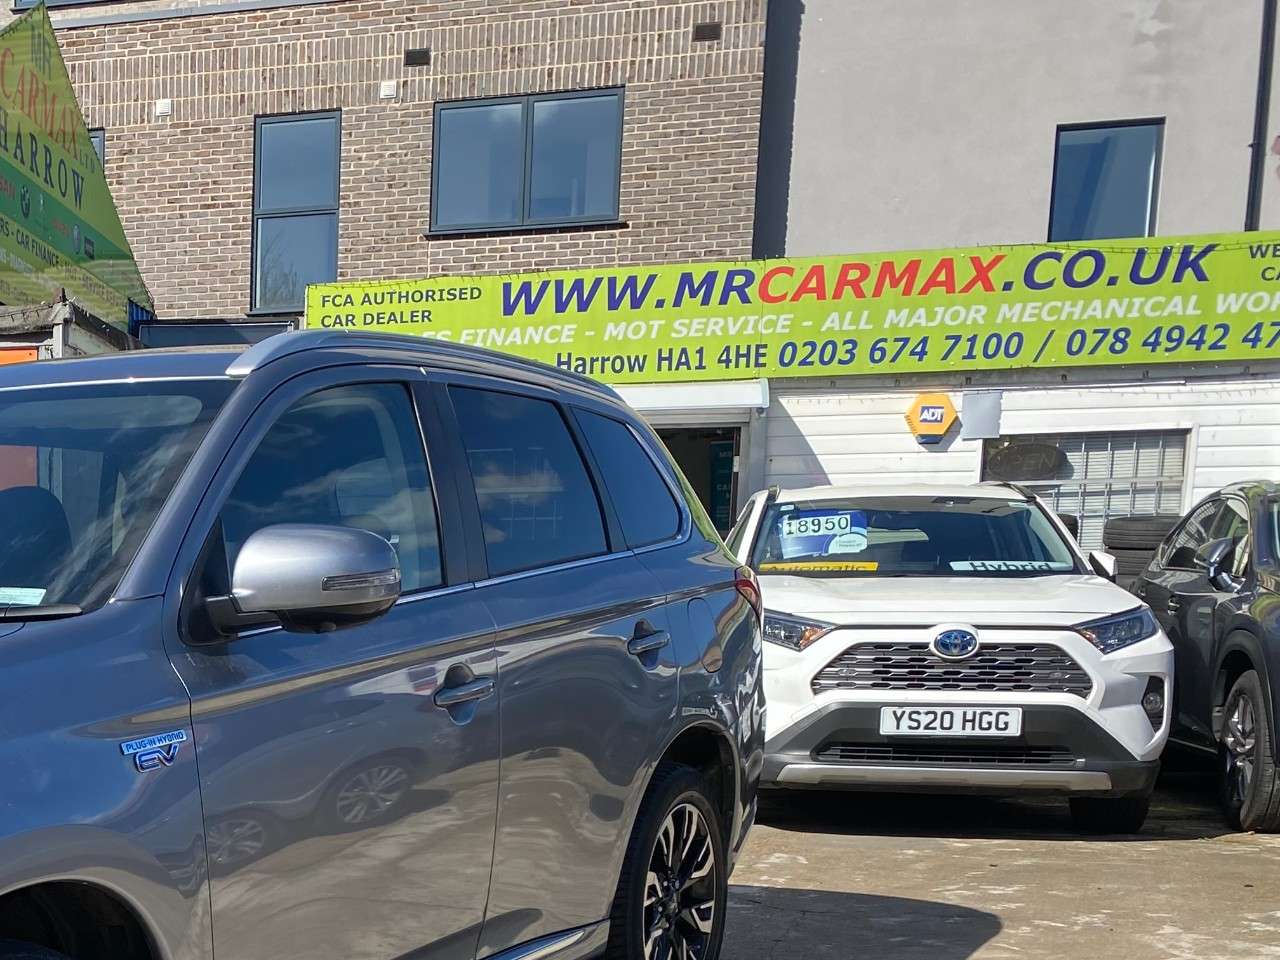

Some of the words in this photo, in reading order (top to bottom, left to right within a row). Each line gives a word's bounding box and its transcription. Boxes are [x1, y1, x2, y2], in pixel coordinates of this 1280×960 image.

[16, 228, 30, 251] CAR
[31, 238, 60, 267] FINANCE
[502, 243, 1220, 317] WWW.MRCARMAX.CO.UK
[321, 294, 355, 308] FCA
[360, 286, 482, 307] AUTHORISED
[320, 313, 356, 328] CAR
[363, 310, 432, 326] DEALER
[459, 324, 577, 347] FINANCE
[603, 319, 666, 341] MOT
[671, 313, 794, 338] SERVICE
[821, 310, 873, 332] ALL
[883, 304, 988, 329] MAJOR
[995, 294, 1203, 324] MECHANICAL
[556, 352, 648, 375] Harrow
[656, 346, 707, 372] HA1
[717, 343, 768, 369] 4HE
[778, 338, 858, 368] 0203
[869, 335, 930, 365] 674
[940, 331, 1024, 362] 7100
[1066, 326, 1132, 357] 078
[1141, 323, 1231, 353] 4942
[919, 407, 945, 421] ADT
[786, 516, 849, 536] 18950
[892, 710, 954, 731] YS20
[961, 711, 1010, 731] HGG
[125, 738, 156, 753] PLUG-IN
[157, 731, 184, 745] HYBRID
[135, 743, 179, 772] EV
